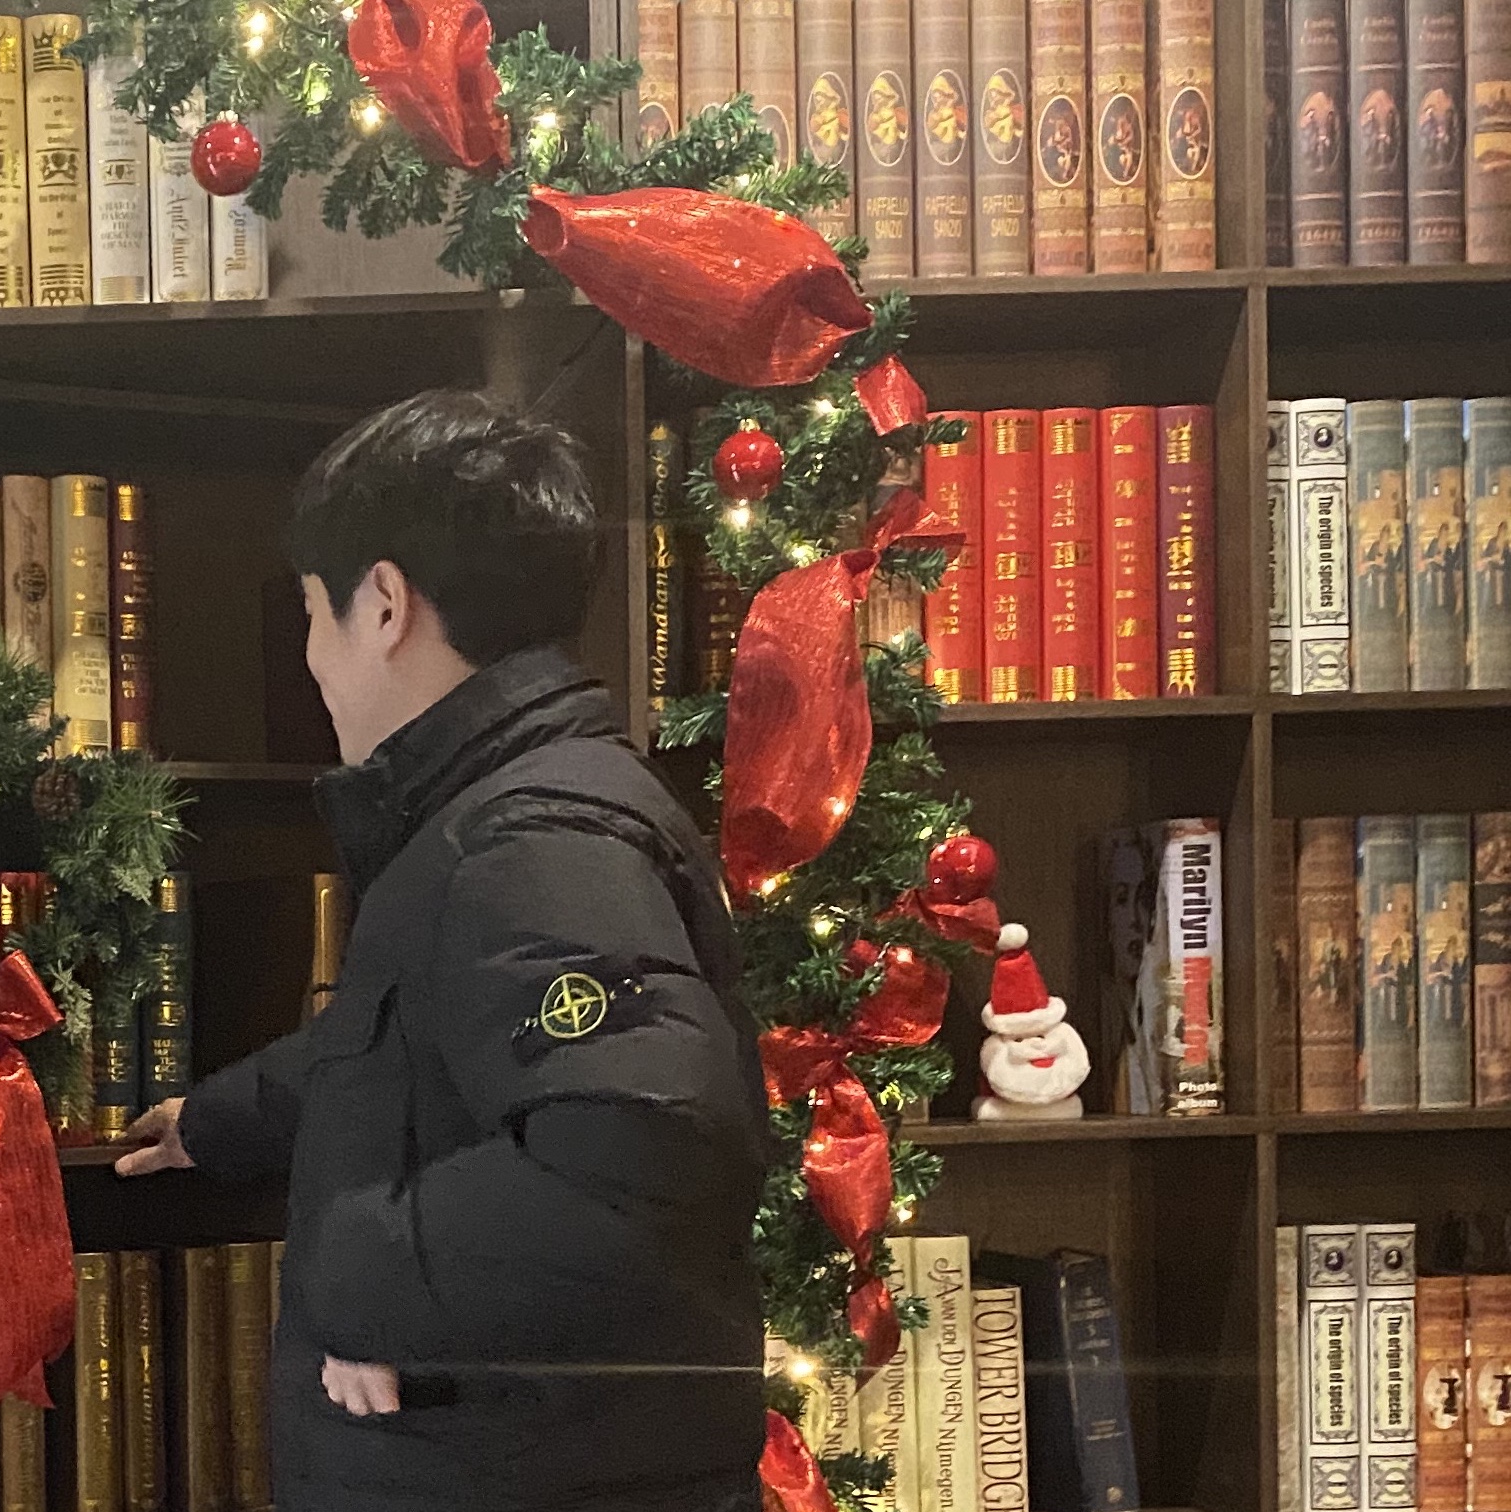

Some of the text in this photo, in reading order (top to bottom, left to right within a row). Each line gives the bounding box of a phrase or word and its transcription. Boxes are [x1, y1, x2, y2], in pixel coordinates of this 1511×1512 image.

[1316, 496, 1335, 607] The origin of species
[649, 569, 669, 691] Wandian
[1180, 844, 1211, 950] Marilyn
[1177, 1096, 1218, 1109] album
[1178, 1081, 1218, 1093] Photo
[941, 1323, 958, 1345] DEN
[1328, 1317, 1343, 1336] The
[1387, 1316, 1402, 1335] The
[975, 1289, 1018, 1410] TOWER
[1327, 1339, 1345, 1371] origin
[1386, 1338, 1404, 1369] origin
[936, 1344, 966, 1424] DUNGEN
[1328, 1385, 1345, 1427] species
[1387, 1384, 1404, 1425] species
